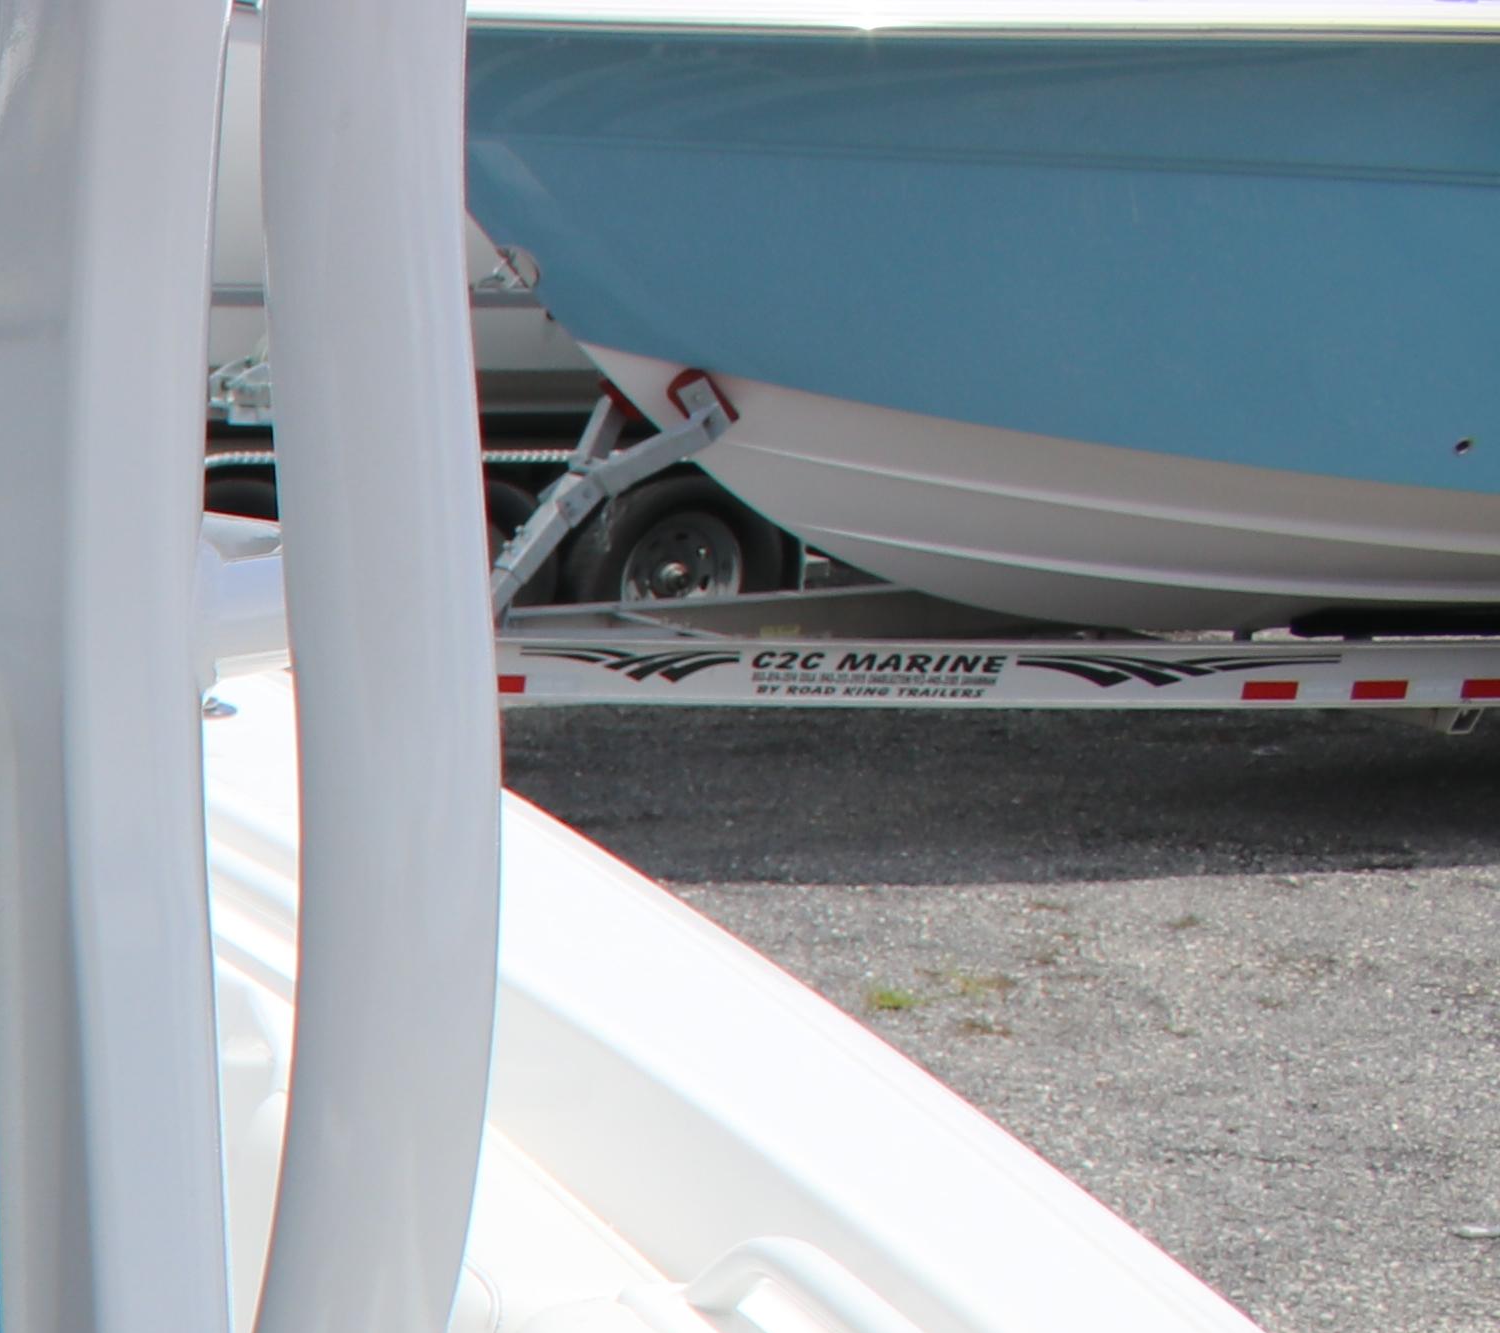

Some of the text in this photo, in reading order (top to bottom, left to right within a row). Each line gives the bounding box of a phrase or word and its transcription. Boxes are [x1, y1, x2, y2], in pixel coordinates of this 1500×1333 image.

[751, 651, 1008, 673] C2C MARINE
[756, 685, 986, 698] BY ROAD KING TRAILERS
